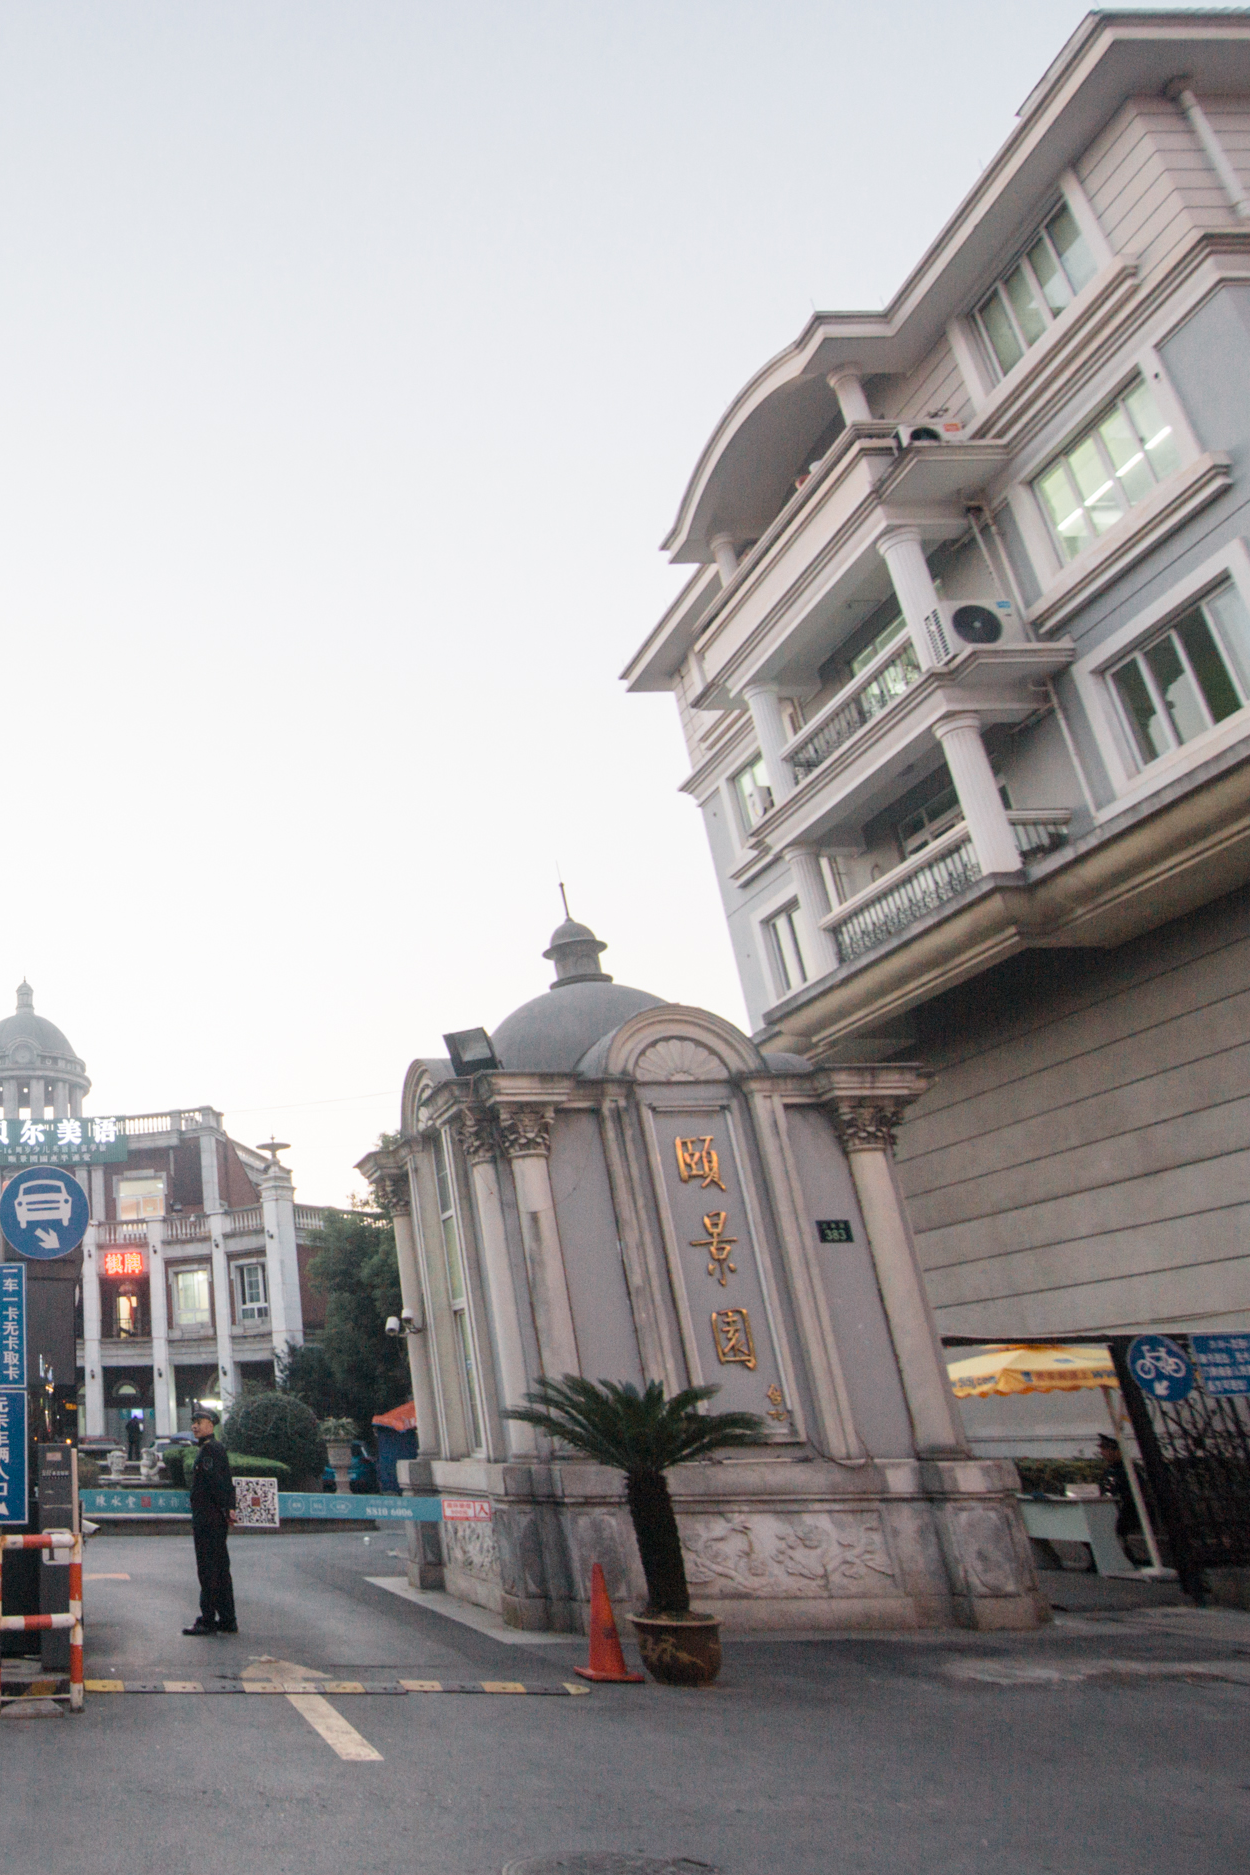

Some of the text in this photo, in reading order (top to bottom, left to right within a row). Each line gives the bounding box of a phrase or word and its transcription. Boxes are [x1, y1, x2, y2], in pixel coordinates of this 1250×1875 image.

[825, 1229, 847, 1240] 383
[105, 1252, 143, 1275] 棋牌
[2, 1268, 20, 1381] 一车一卡无卡取卡
[391, 1507, 413, 1517] 6006
[477, 1503, 489, 1516] 入
